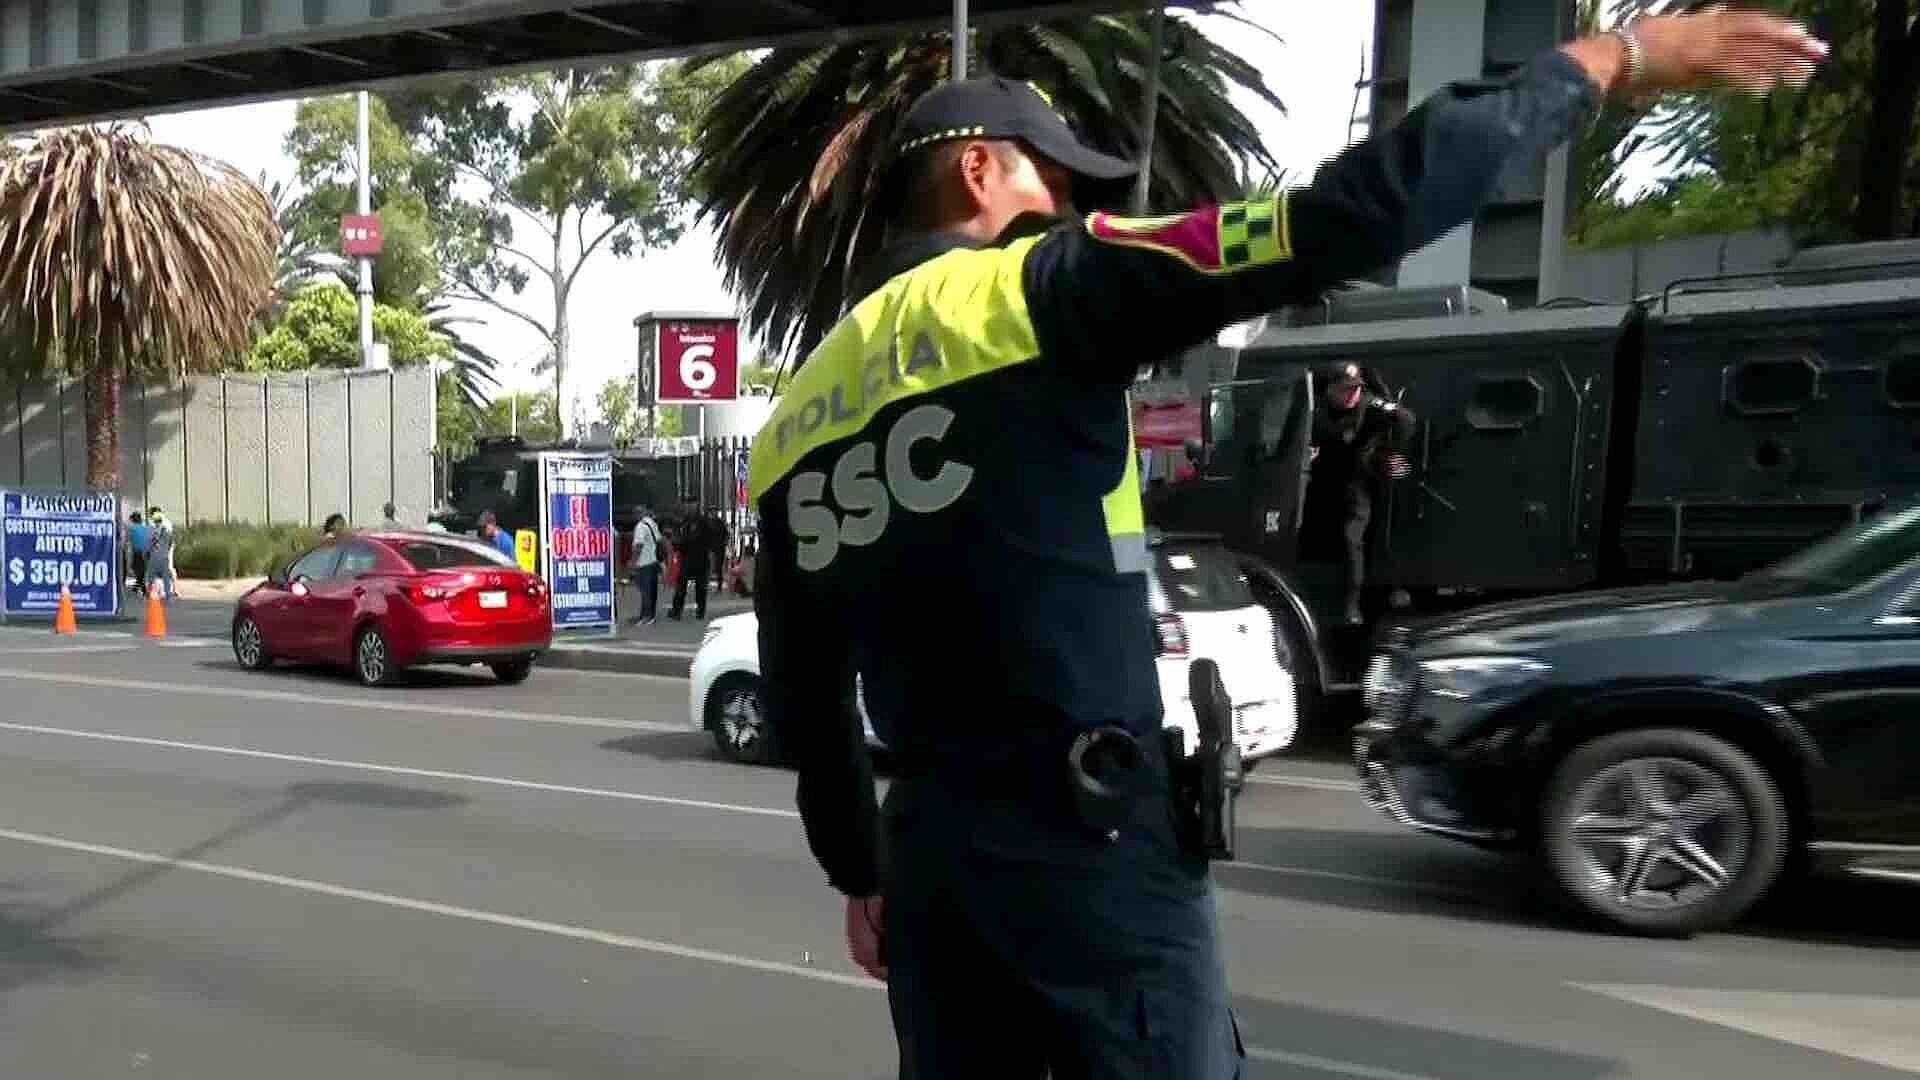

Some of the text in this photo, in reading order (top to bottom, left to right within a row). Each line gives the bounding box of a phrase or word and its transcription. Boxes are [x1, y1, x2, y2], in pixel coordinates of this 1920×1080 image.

[680, 344, 717, 391] 6
[787, 404, 975, 572] SSC
[570, 496, 590, 527] EL
[35, 536, 84, 552] AUTOS
[552, 528, 609, 559] COBRO
[9, 557, 109, 586] $ 350.00
